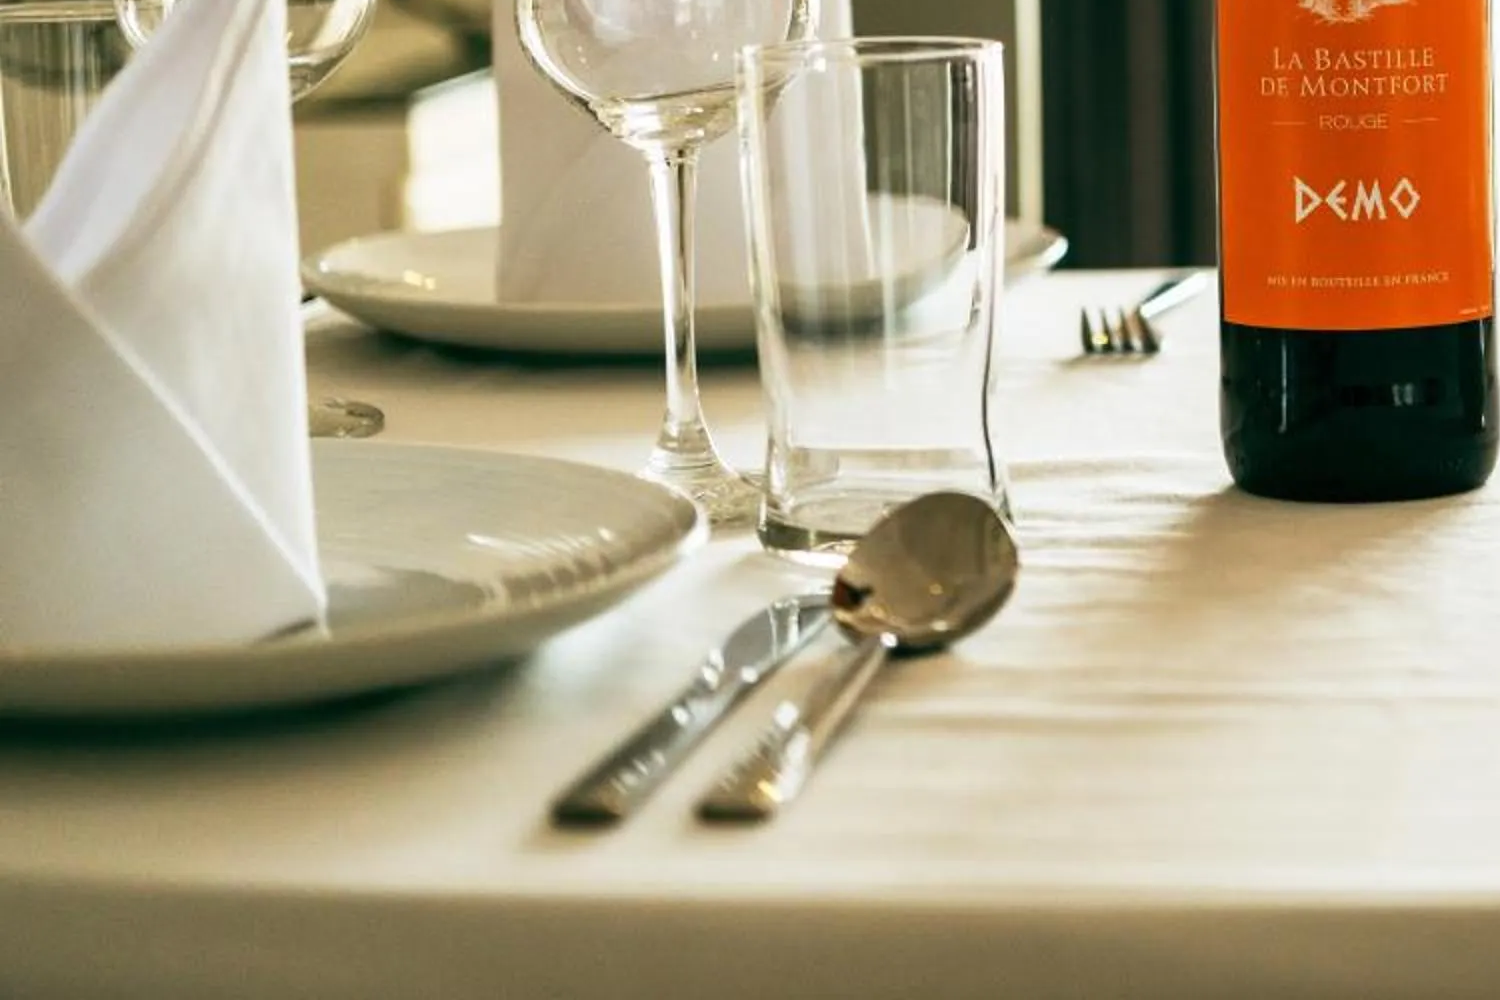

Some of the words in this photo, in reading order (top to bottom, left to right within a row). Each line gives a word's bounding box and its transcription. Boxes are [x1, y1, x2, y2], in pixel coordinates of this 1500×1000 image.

[1260, 76, 1290, 98] DE
[1318, 112, 1390, 130] ROUGE
[1293, 174, 1421, 224] DEMO
[1404, 271, 1450, 285] FRANCE
